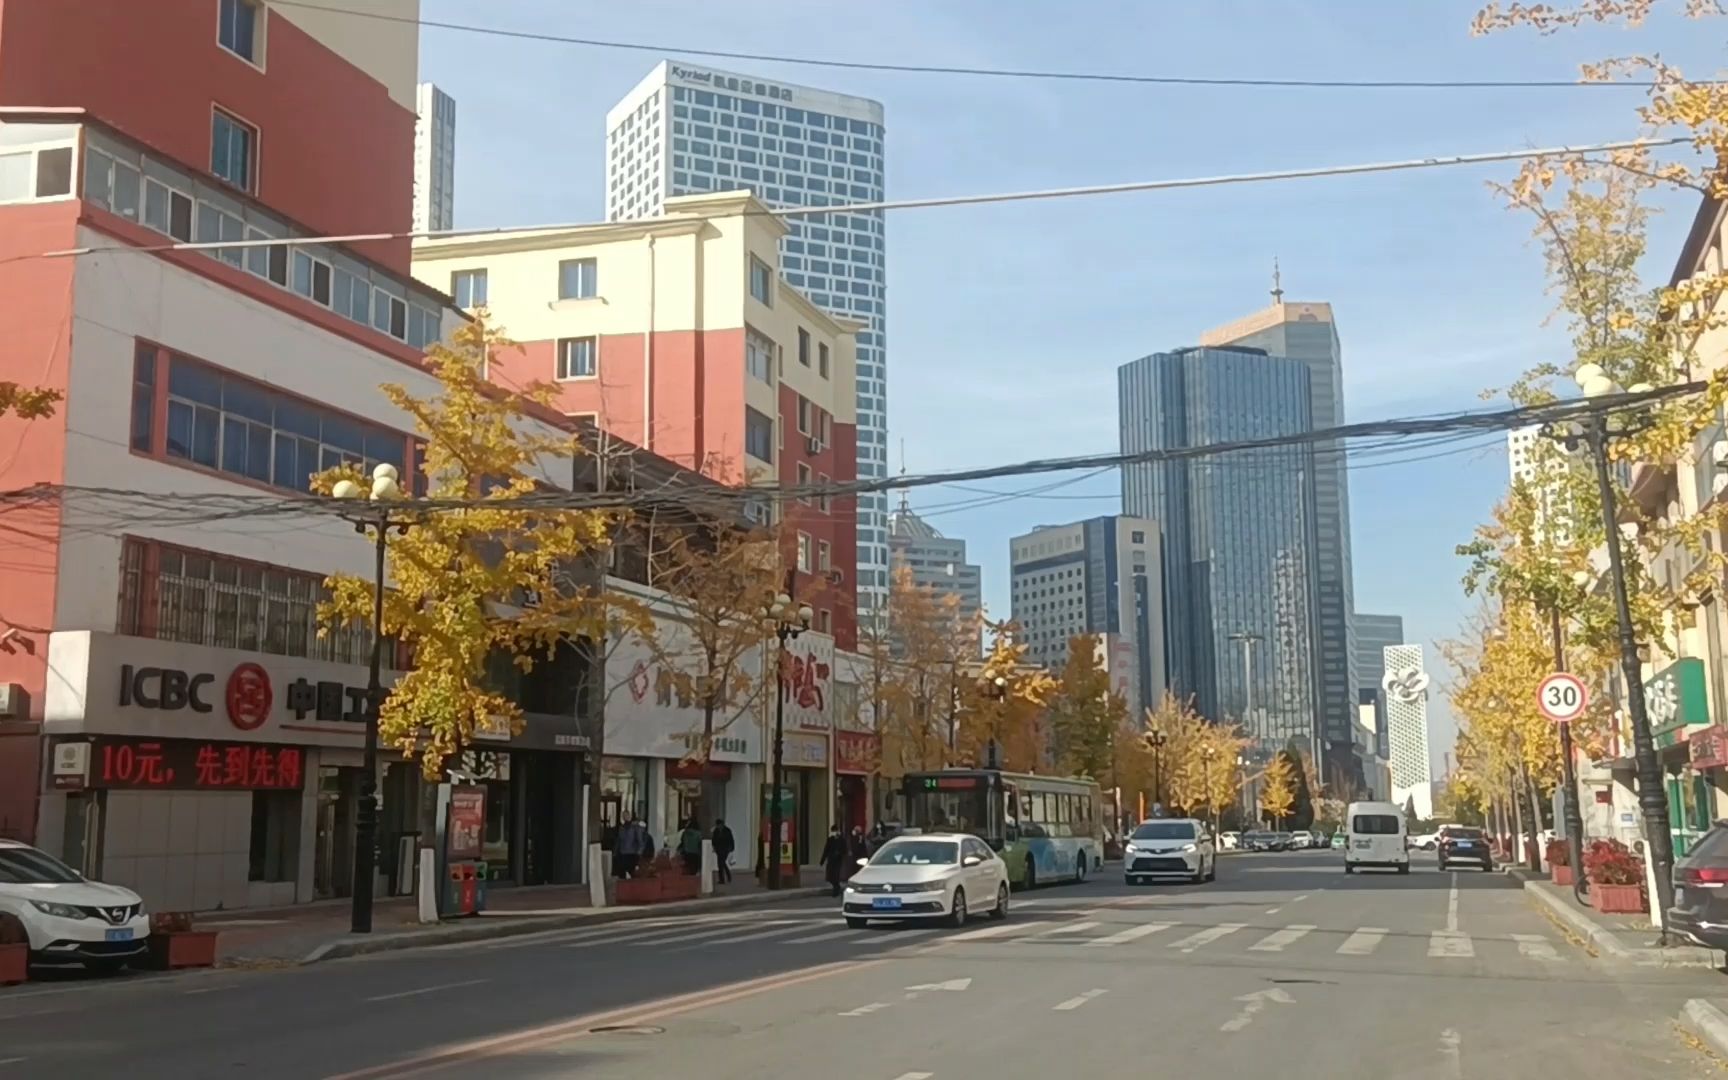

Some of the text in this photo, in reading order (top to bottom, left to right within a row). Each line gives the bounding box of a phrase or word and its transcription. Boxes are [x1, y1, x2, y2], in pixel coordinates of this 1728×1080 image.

[119, 664, 216, 713] ICBC
[287, 677, 388, 722] 中国工
[1548, 686, 1576, 706] 30
